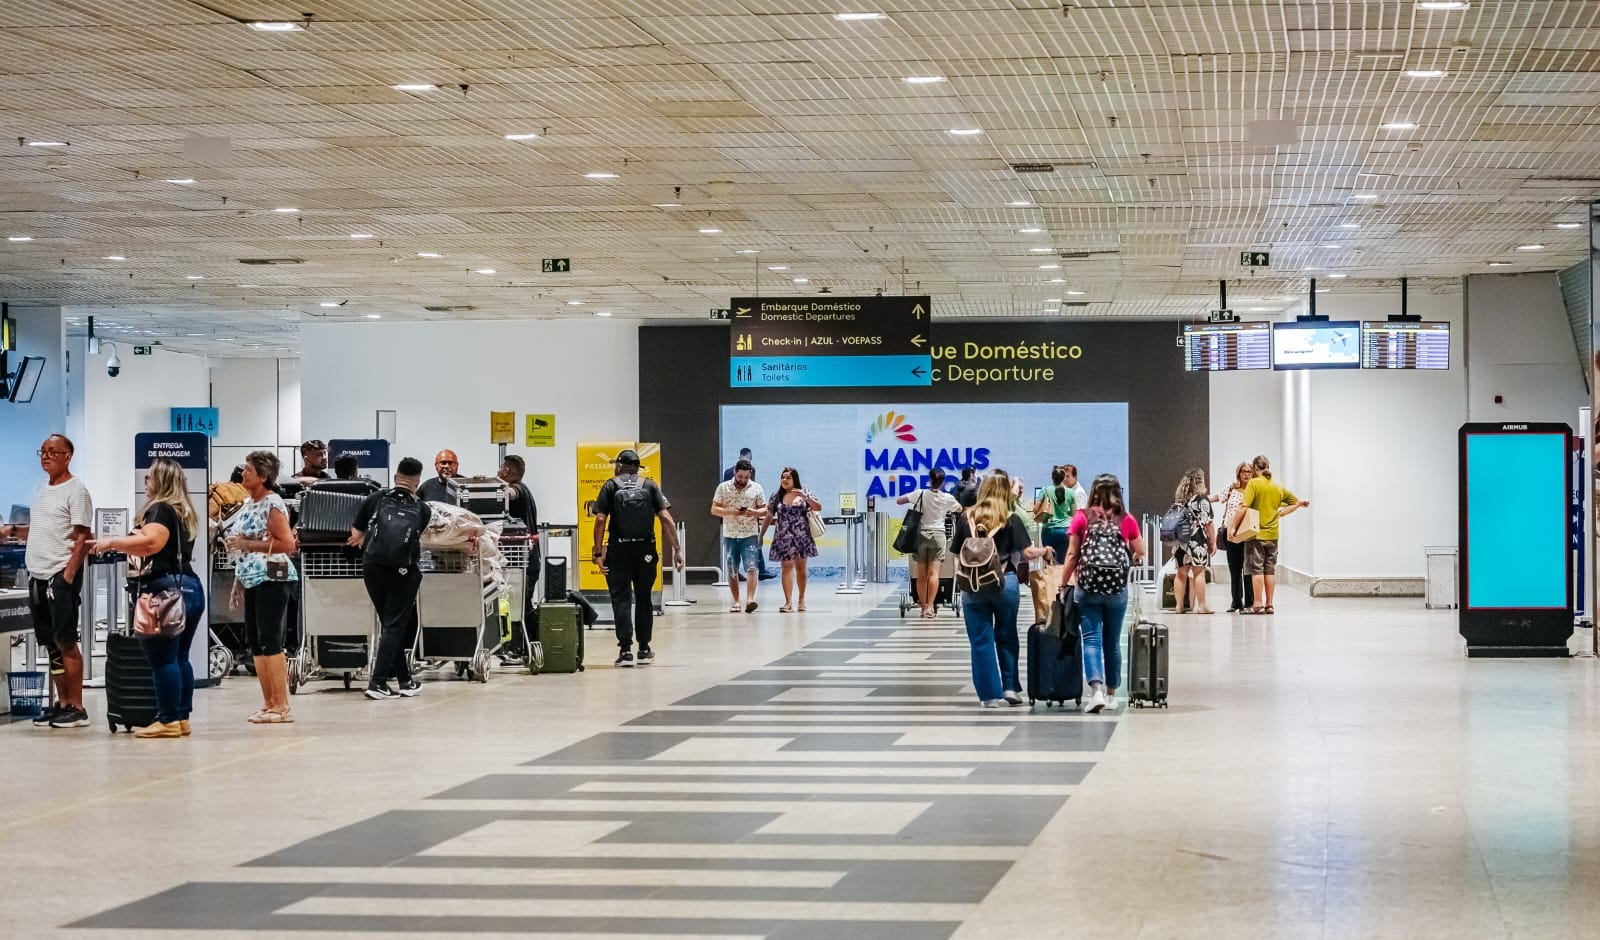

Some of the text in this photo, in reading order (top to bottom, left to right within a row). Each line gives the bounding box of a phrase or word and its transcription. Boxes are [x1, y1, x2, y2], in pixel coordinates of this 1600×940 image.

[761, 302, 861, 312] Embarque Doméstico
[761, 312, 856, 322] Domestic Departures
[761, 337, 802, 346] Check-in
[810, 336, 834, 345] AZUL
[841, 336, 882, 345] VOEPASS
[964, 340, 1083, 360] Doméstico
[761, 362, 808, 371] Sanitários
[762, 373, 790, 382] Toilets
[948, 365, 1054, 385] Departure
[865, 447, 990, 471] MANAUS
